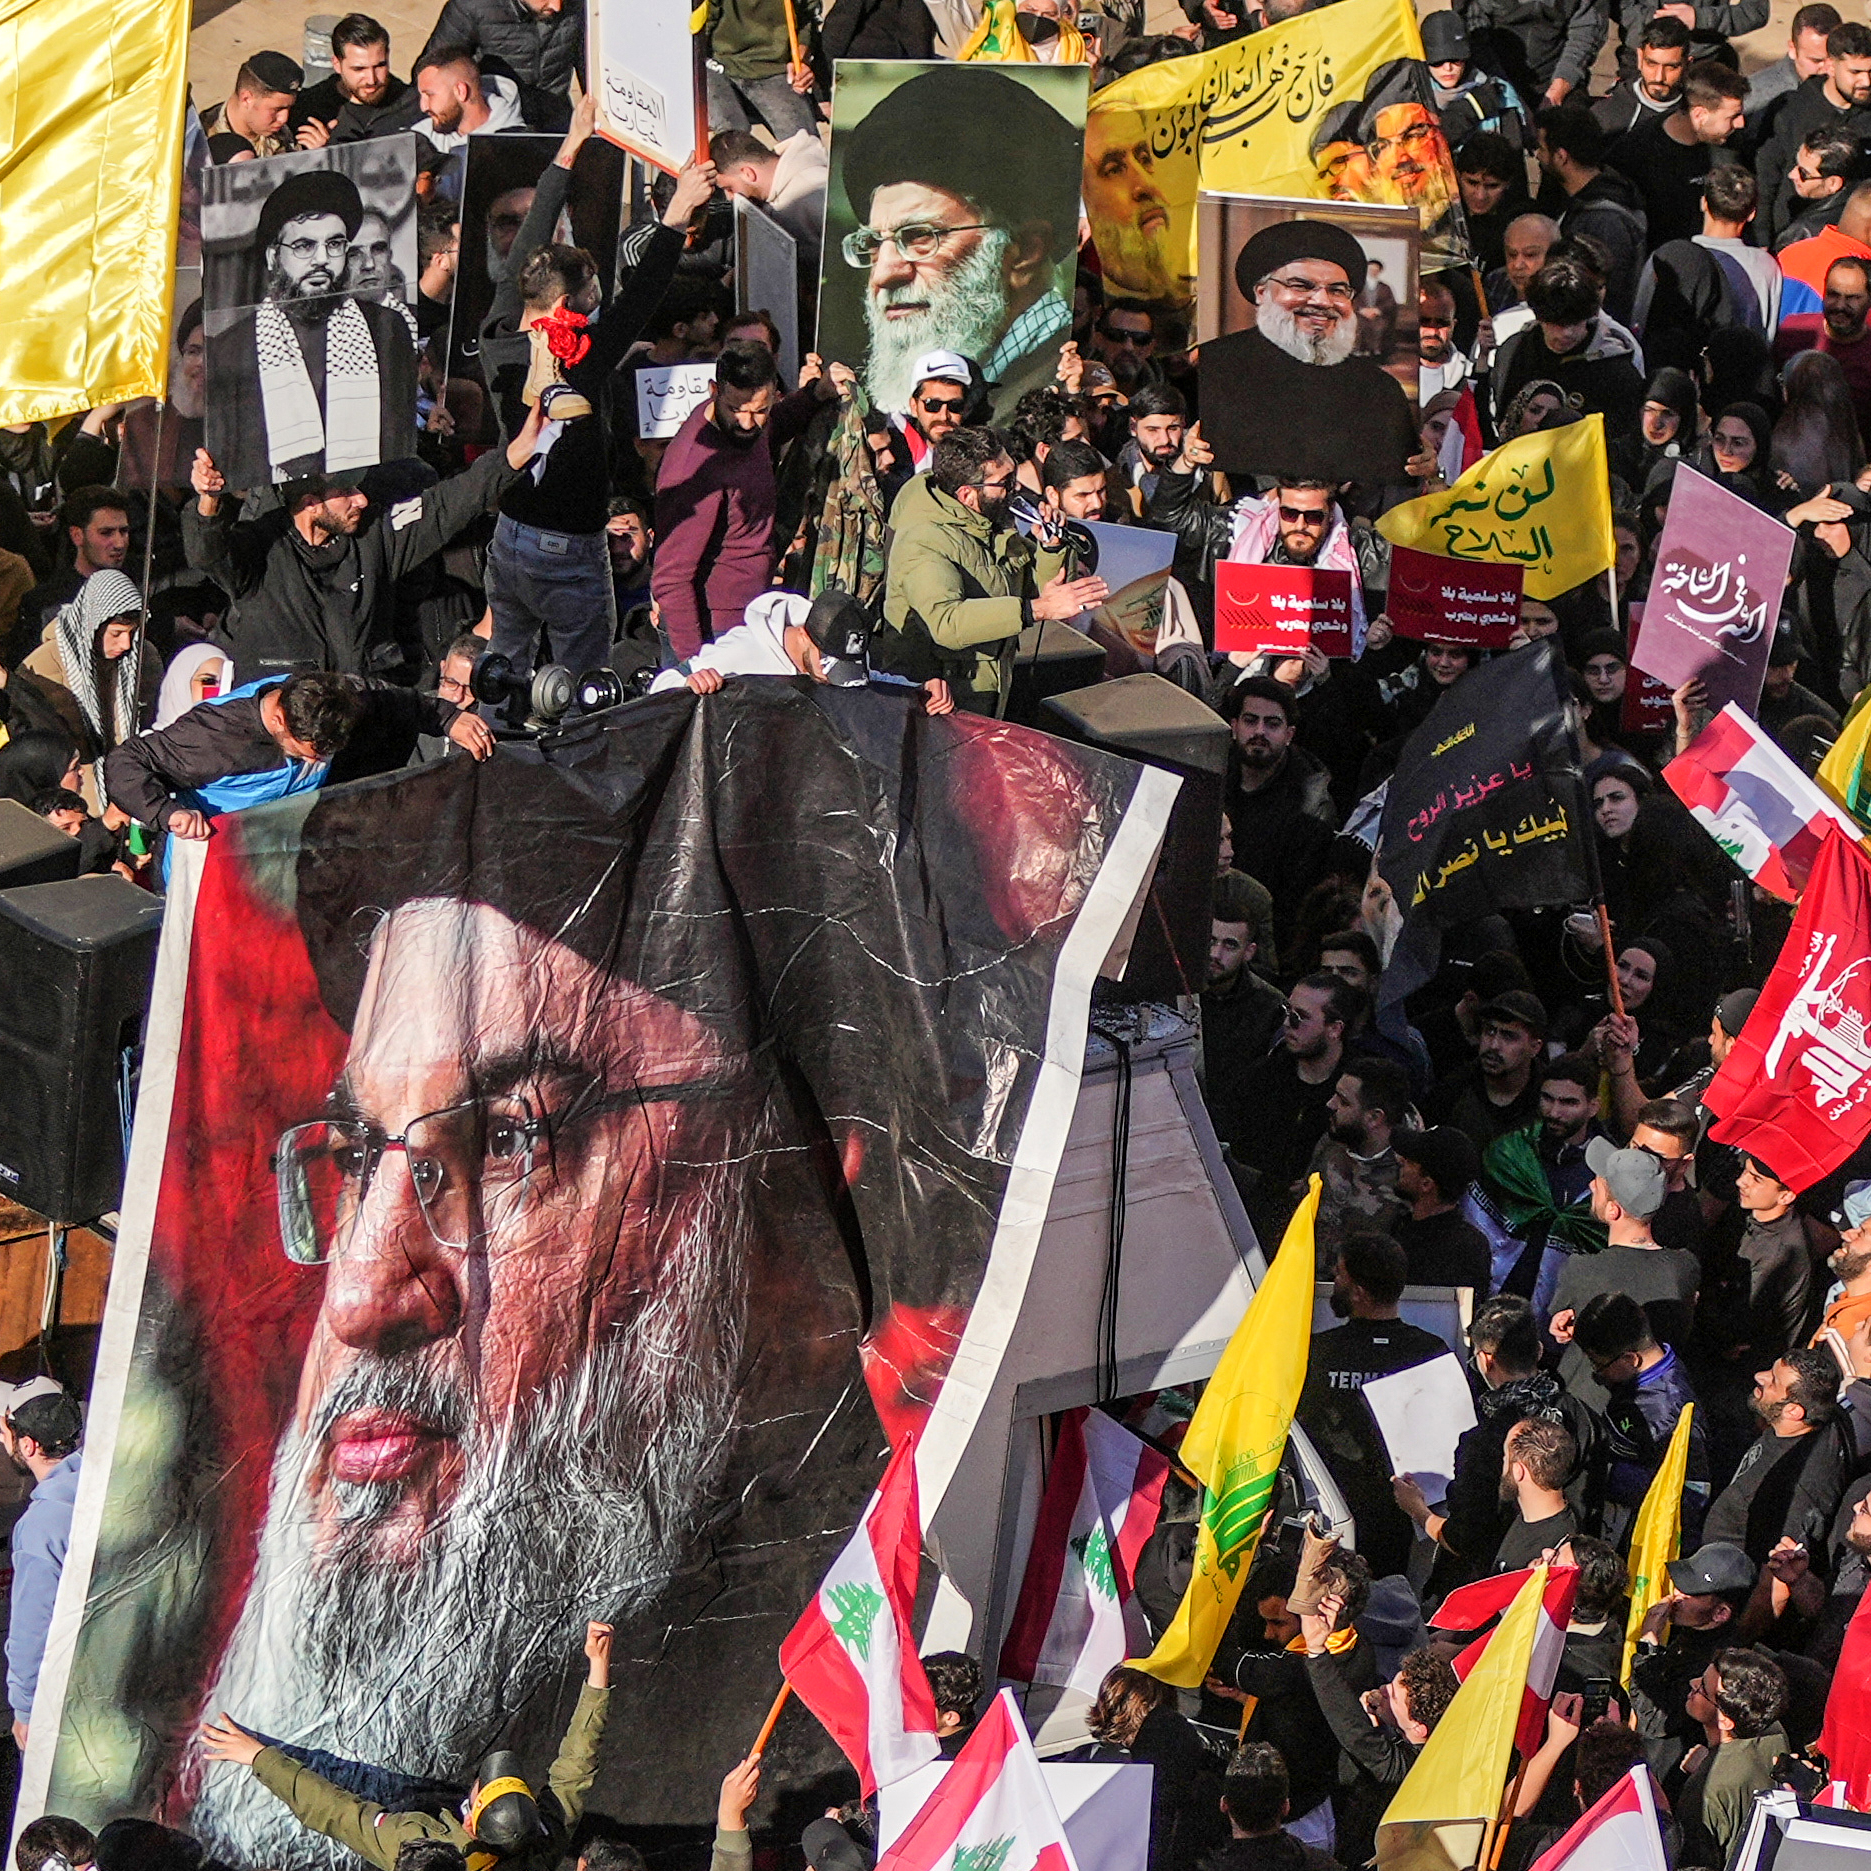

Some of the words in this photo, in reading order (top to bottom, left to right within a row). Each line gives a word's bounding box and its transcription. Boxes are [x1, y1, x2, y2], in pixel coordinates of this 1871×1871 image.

[1494, 458, 1554, 521] لن
[1446, 522, 1553, 574] السلاح
[1483, 828, 1508, 857] يا
